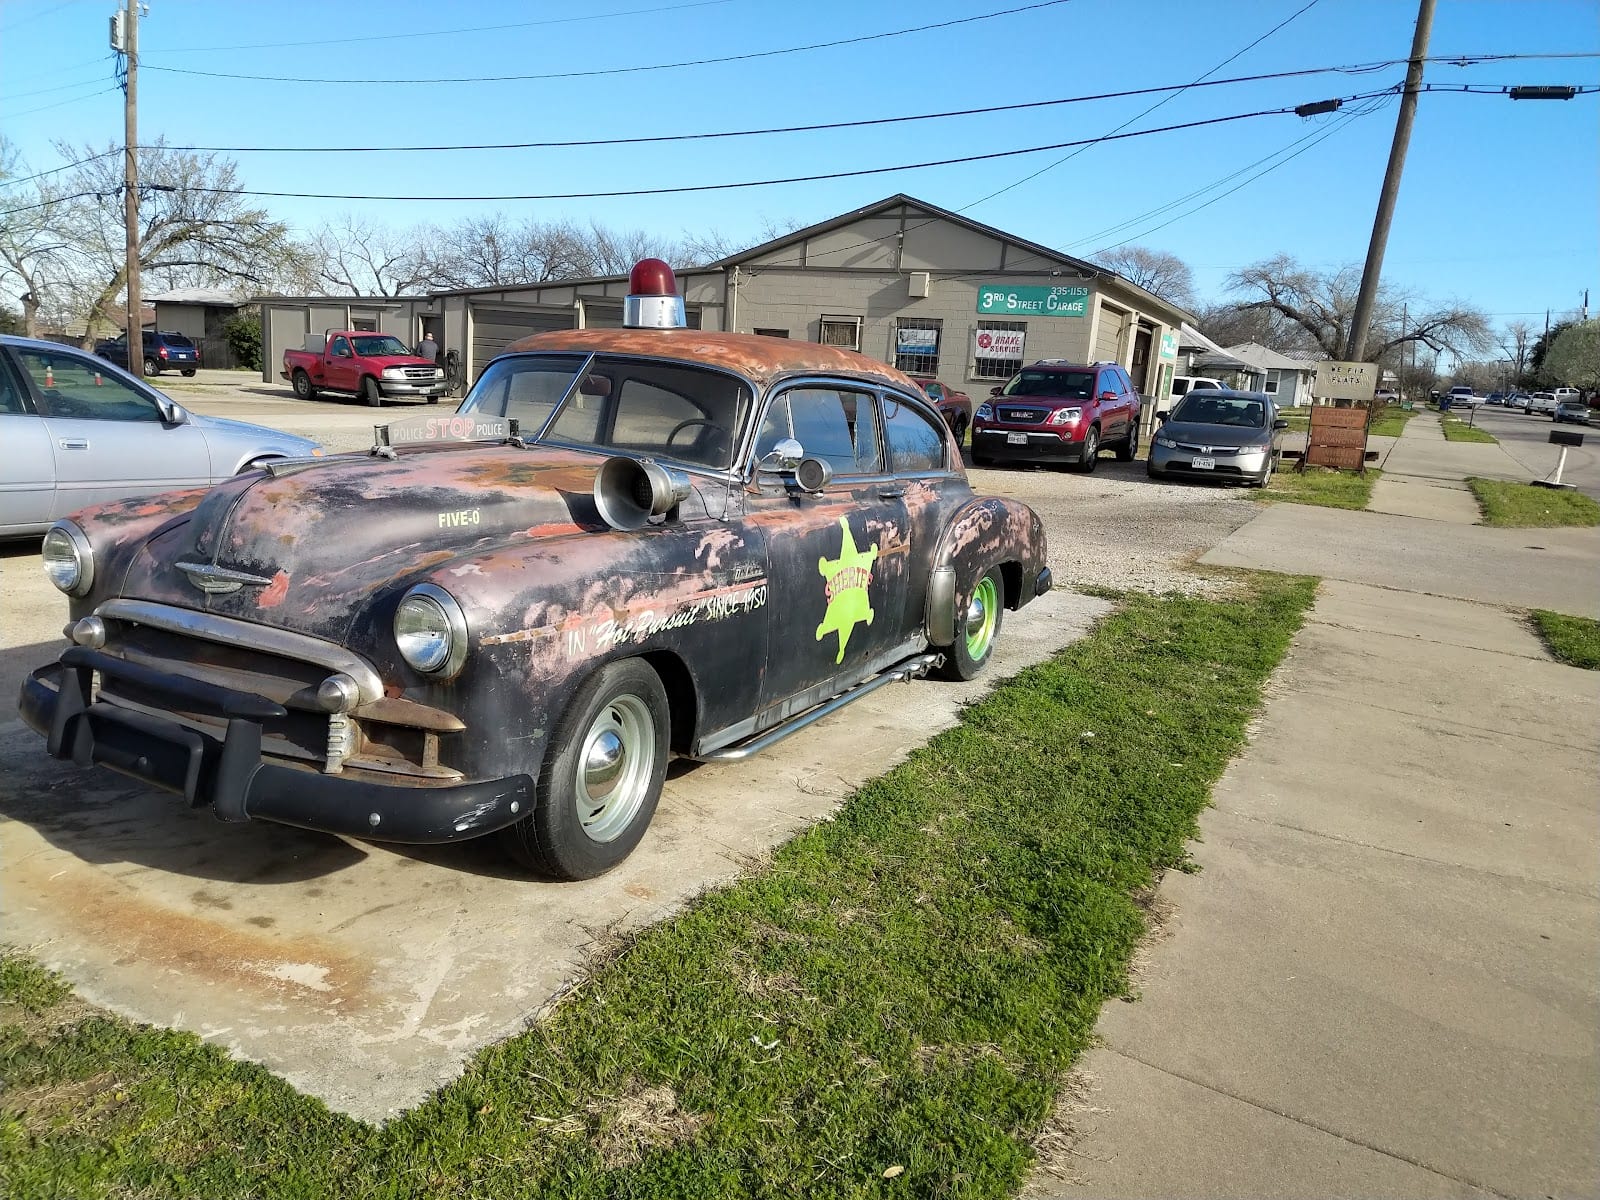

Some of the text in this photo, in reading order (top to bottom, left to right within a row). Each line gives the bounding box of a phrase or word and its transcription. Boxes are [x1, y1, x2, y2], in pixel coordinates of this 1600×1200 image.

[995, 336, 1021, 345] BRAKE
[394, 416, 502, 441] POLICE STOP POLICE
[568, 627, 586, 656] IN
[707, 592, 739, 620] SINCE
[743, 585, 767, 613] 1950
